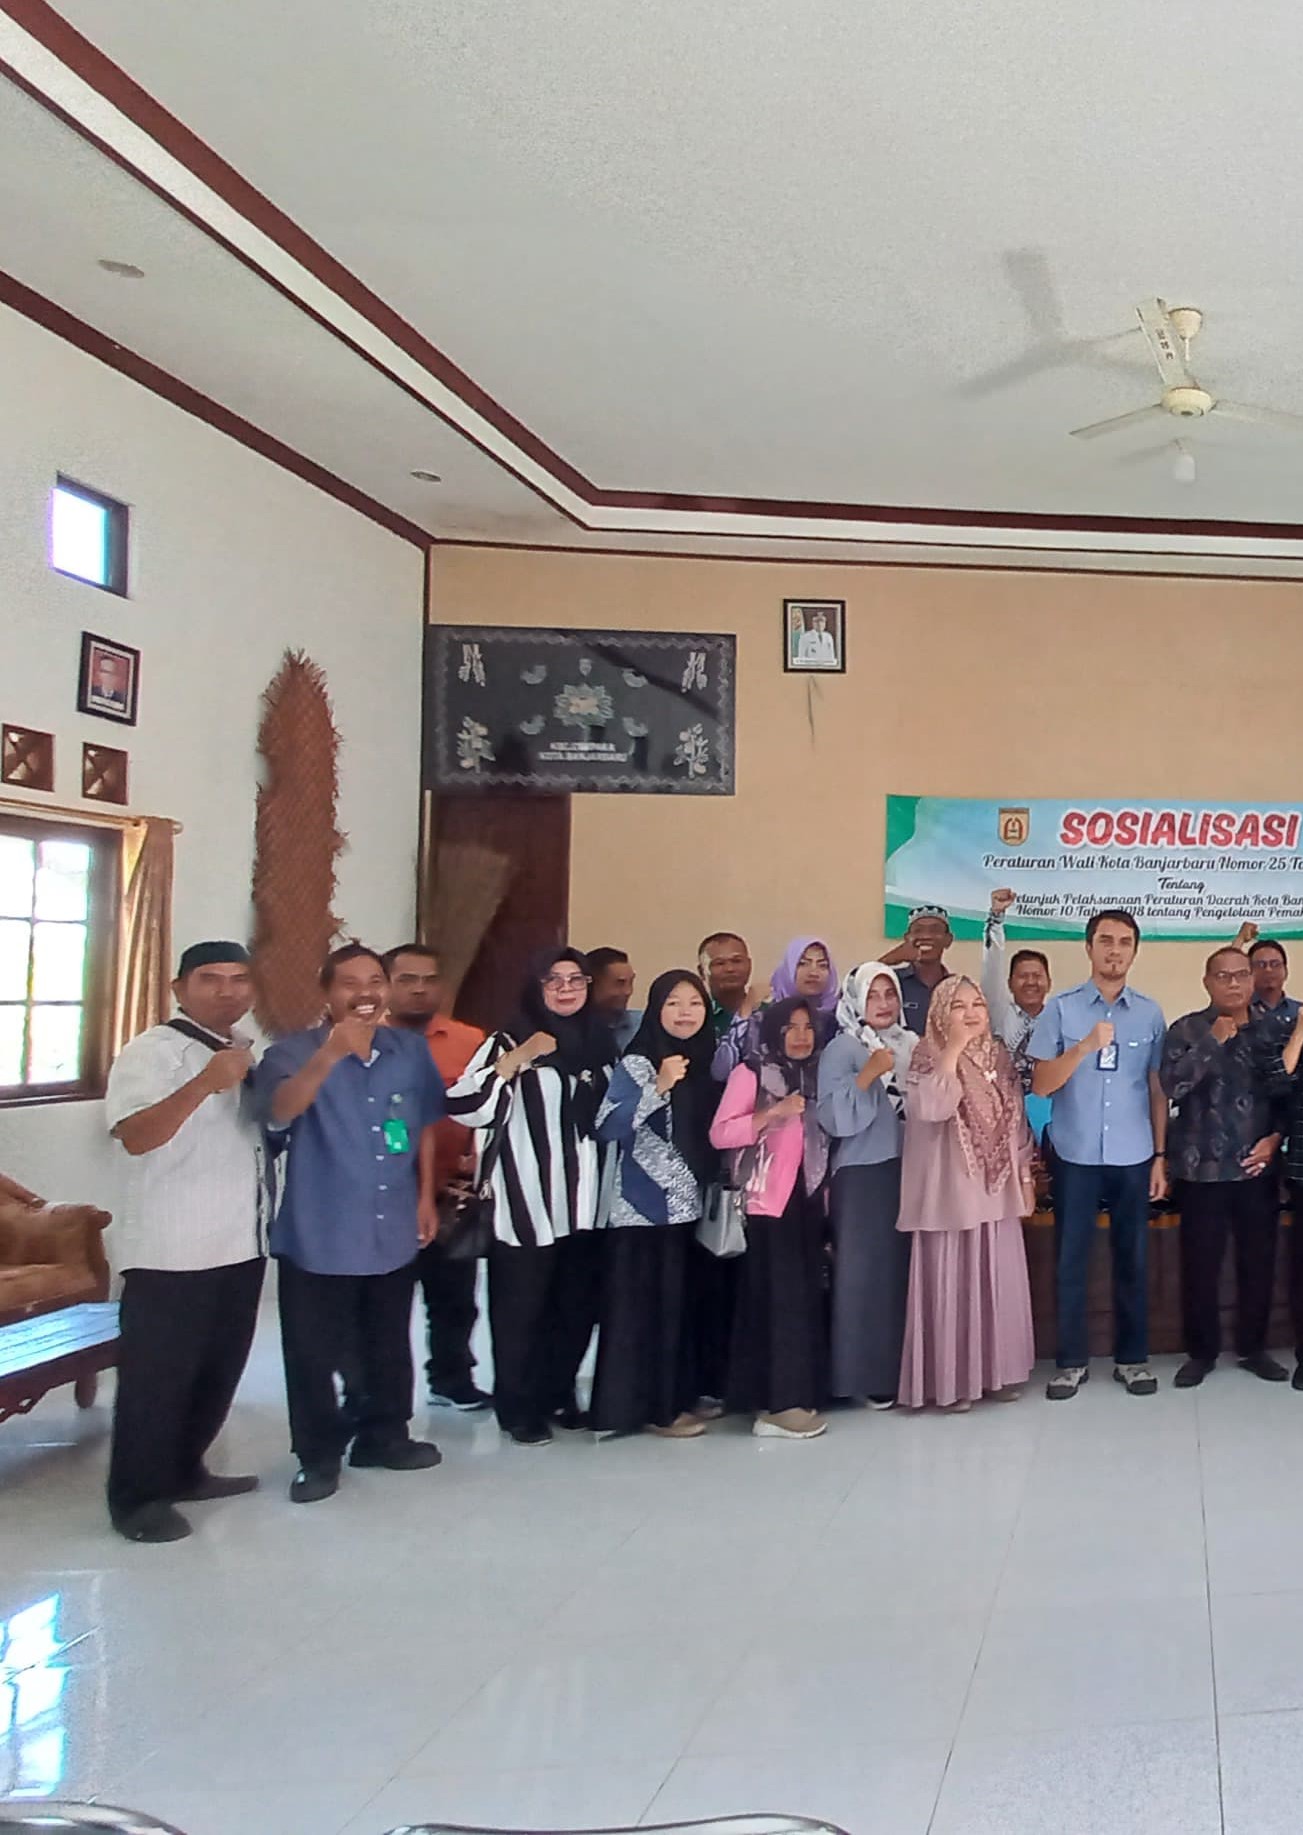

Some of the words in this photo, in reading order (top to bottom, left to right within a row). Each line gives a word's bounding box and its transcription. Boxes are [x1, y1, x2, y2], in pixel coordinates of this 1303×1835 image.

[1058, 810, 1300, 849] SOSIALISASI
[983, 854, 1055, 869] Peraturan
[1058, 854, 1094, 870] Wali
[1097, 854, 1130, 869] Kota
[1132, 855, 1215, 873] Banjarbaru
[1217, 856, 1265, 871] Nomor
[1268, 856, 1286, 871] 25
[1157, 877, 1205, 894] Tentang
[1016, 893, 1060, 906] etunjuk
[1063, 893, 1141, 905] Pelaksanaan
[1143, 893, 1204, 906] Peraturan
[1205, 894, 1250, 906] Daerah
[1253, 894, 1279, 906] Kota
[1016, 904, 1056, 916] Nomor
[1060, 905, 1074, 917] 10
[1146, 906, 1191, 919] tentang
[1194, 906, 1265, 919] Pengelolaan
